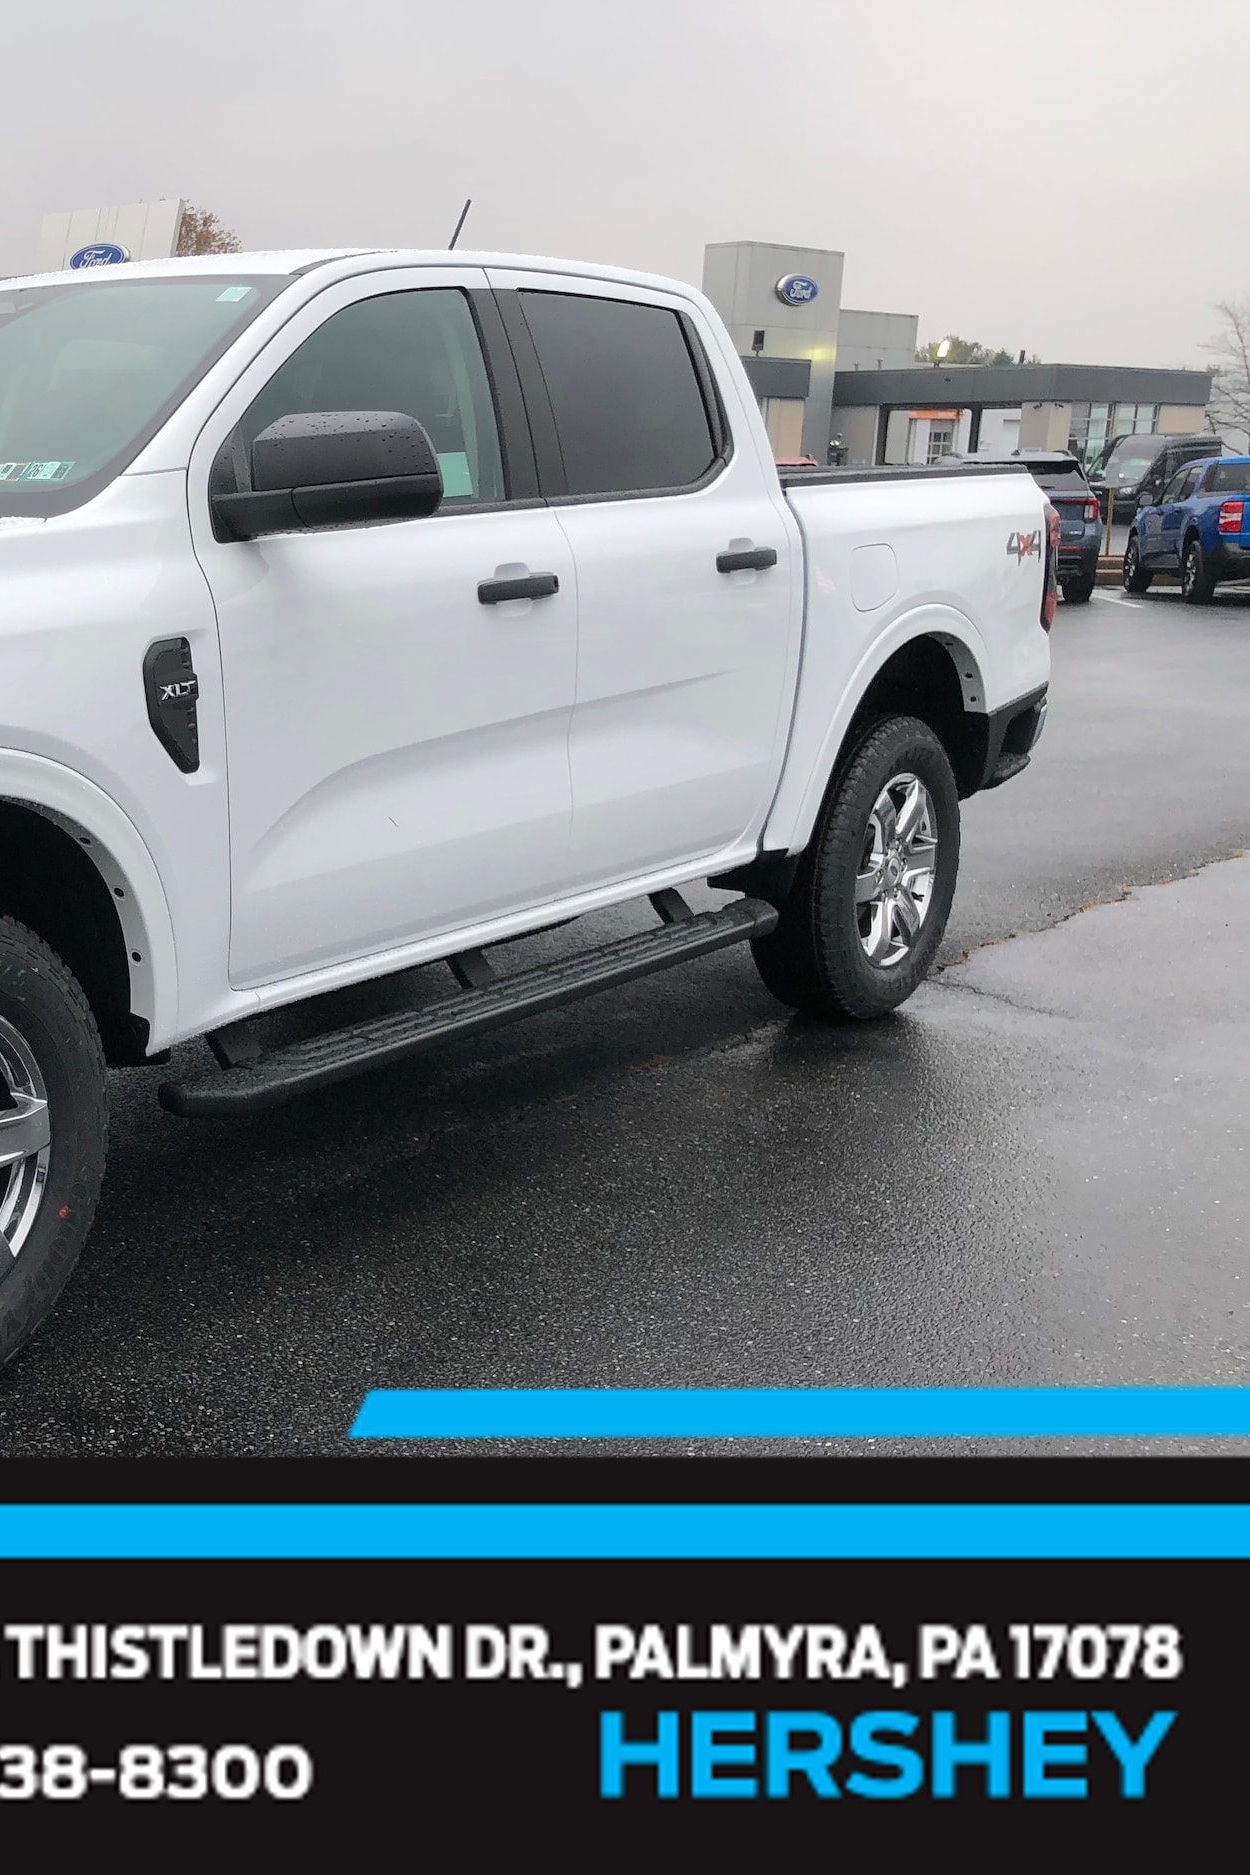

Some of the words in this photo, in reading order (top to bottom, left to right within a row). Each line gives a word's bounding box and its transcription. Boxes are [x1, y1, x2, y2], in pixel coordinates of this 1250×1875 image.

[79, 249, 112, 269] Ford
[790, 280, 812, 299] Ford
[159, 680, 196, 701] XLT
